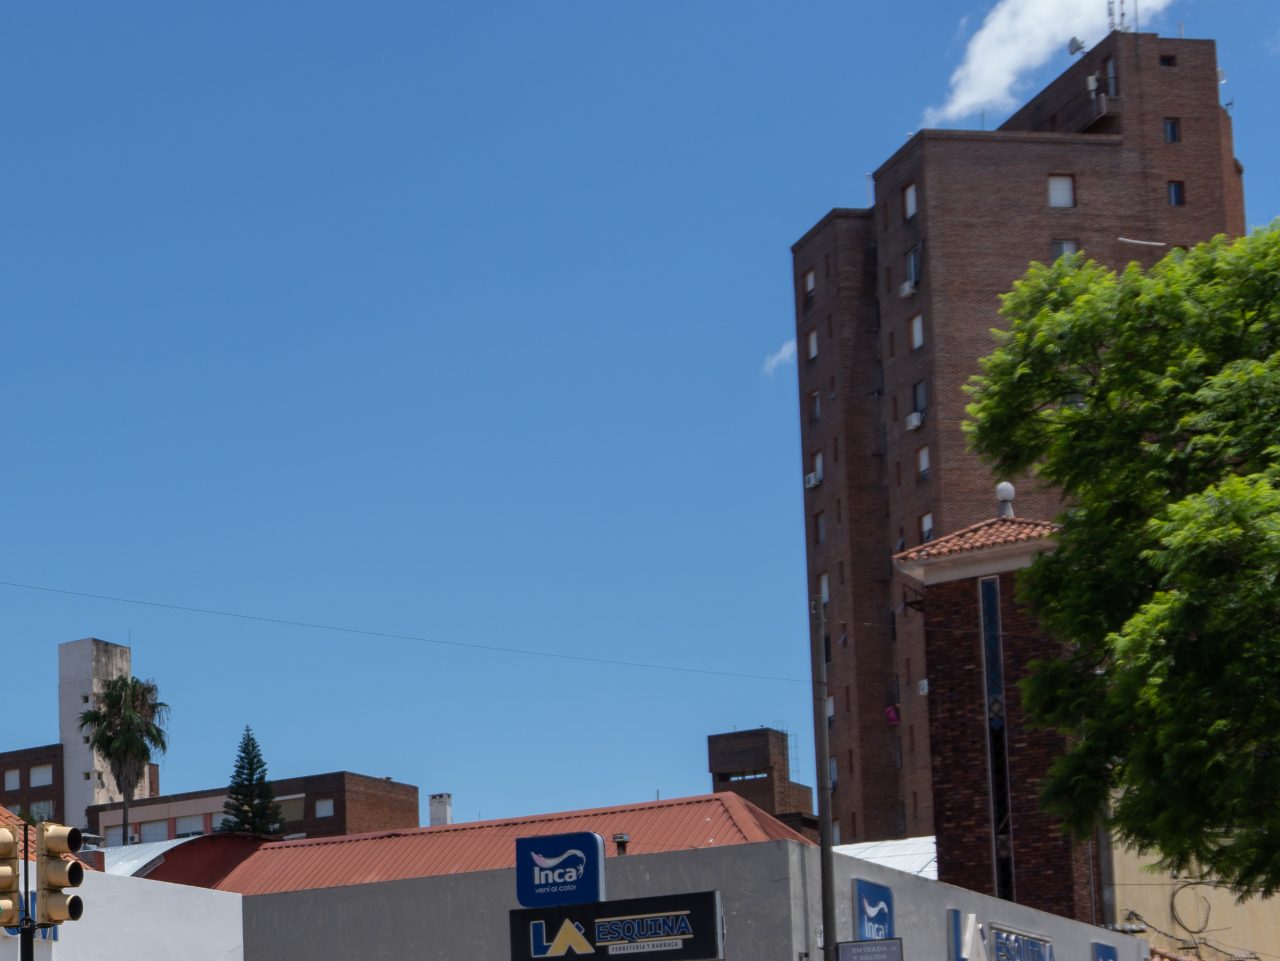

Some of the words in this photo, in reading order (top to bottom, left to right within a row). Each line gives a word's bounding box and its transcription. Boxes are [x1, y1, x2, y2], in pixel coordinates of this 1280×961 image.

[534, 866, 577, 884] Inca
[530, 918, 595, 958] LA
[595, 915, 693, 942] ESQUINA
[864, 914, 885, 940] Inca
